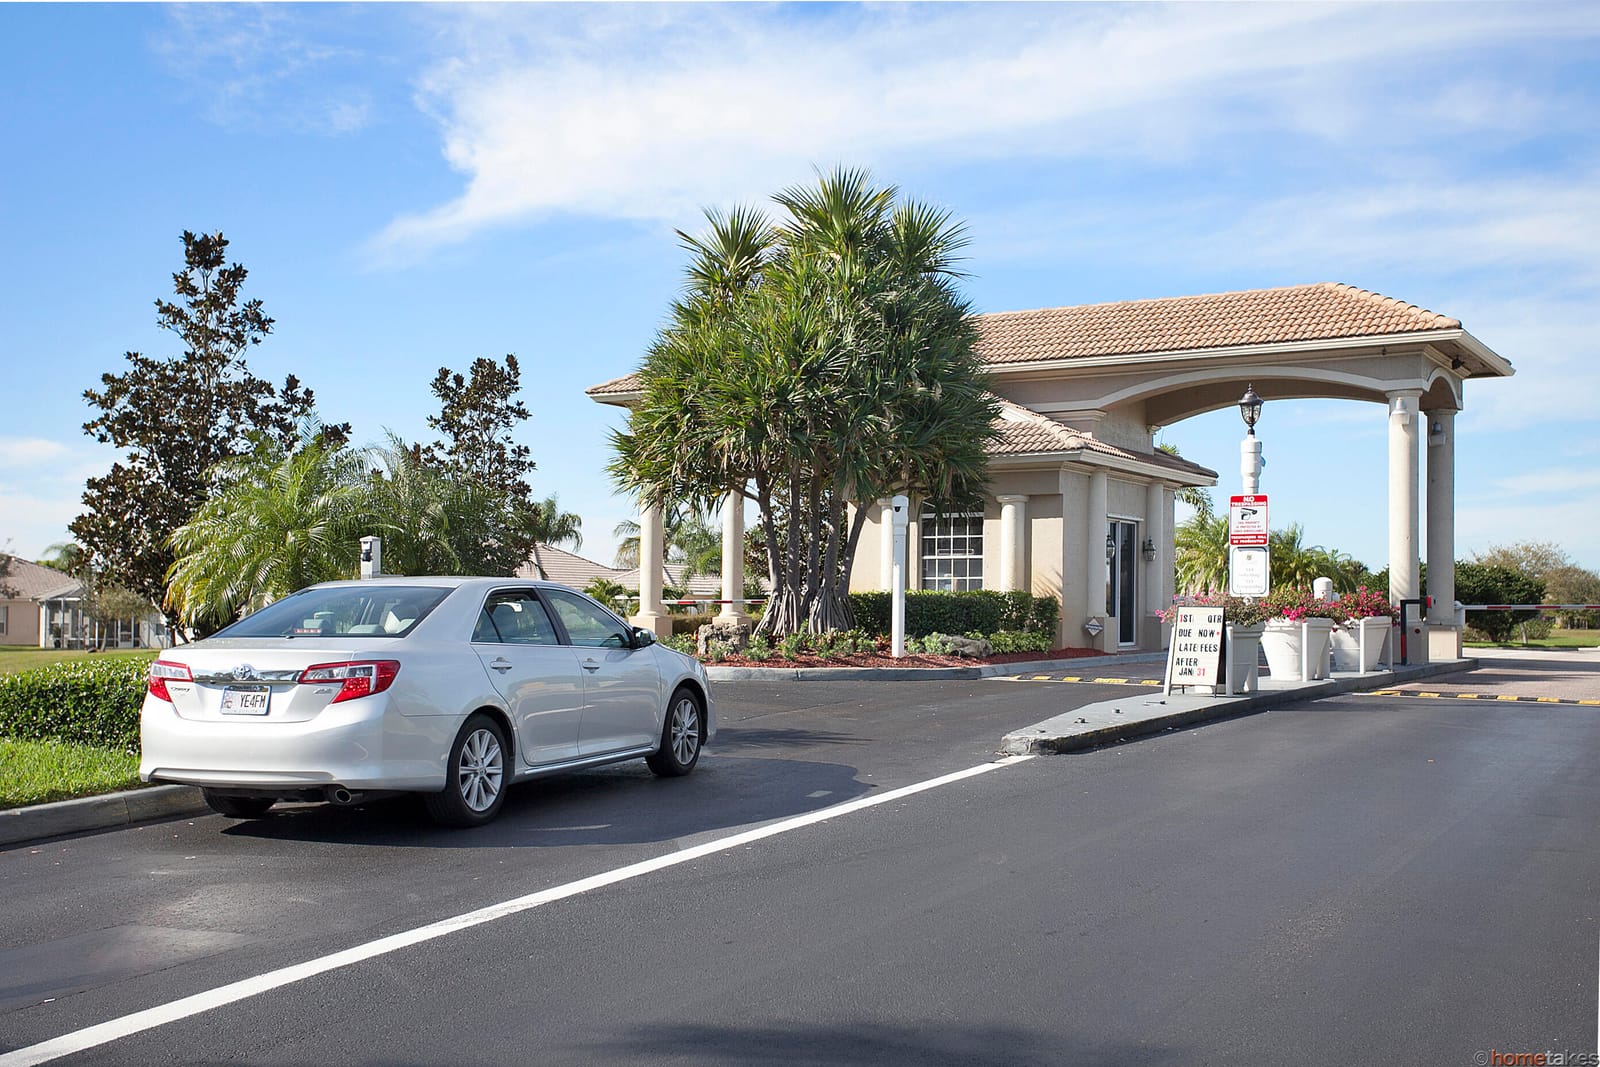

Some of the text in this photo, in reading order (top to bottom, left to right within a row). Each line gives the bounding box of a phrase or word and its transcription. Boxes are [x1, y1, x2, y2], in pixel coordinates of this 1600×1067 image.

[1179, 614, 1222, 623] 1ST QTR
[1178, 629, 1192, 637] DUE
[1178, 643, 1218, 652] LATE FEES
[1175, 657, 1198, 666] AFTER
[1178, 668, 1206, 676] JAN 31
